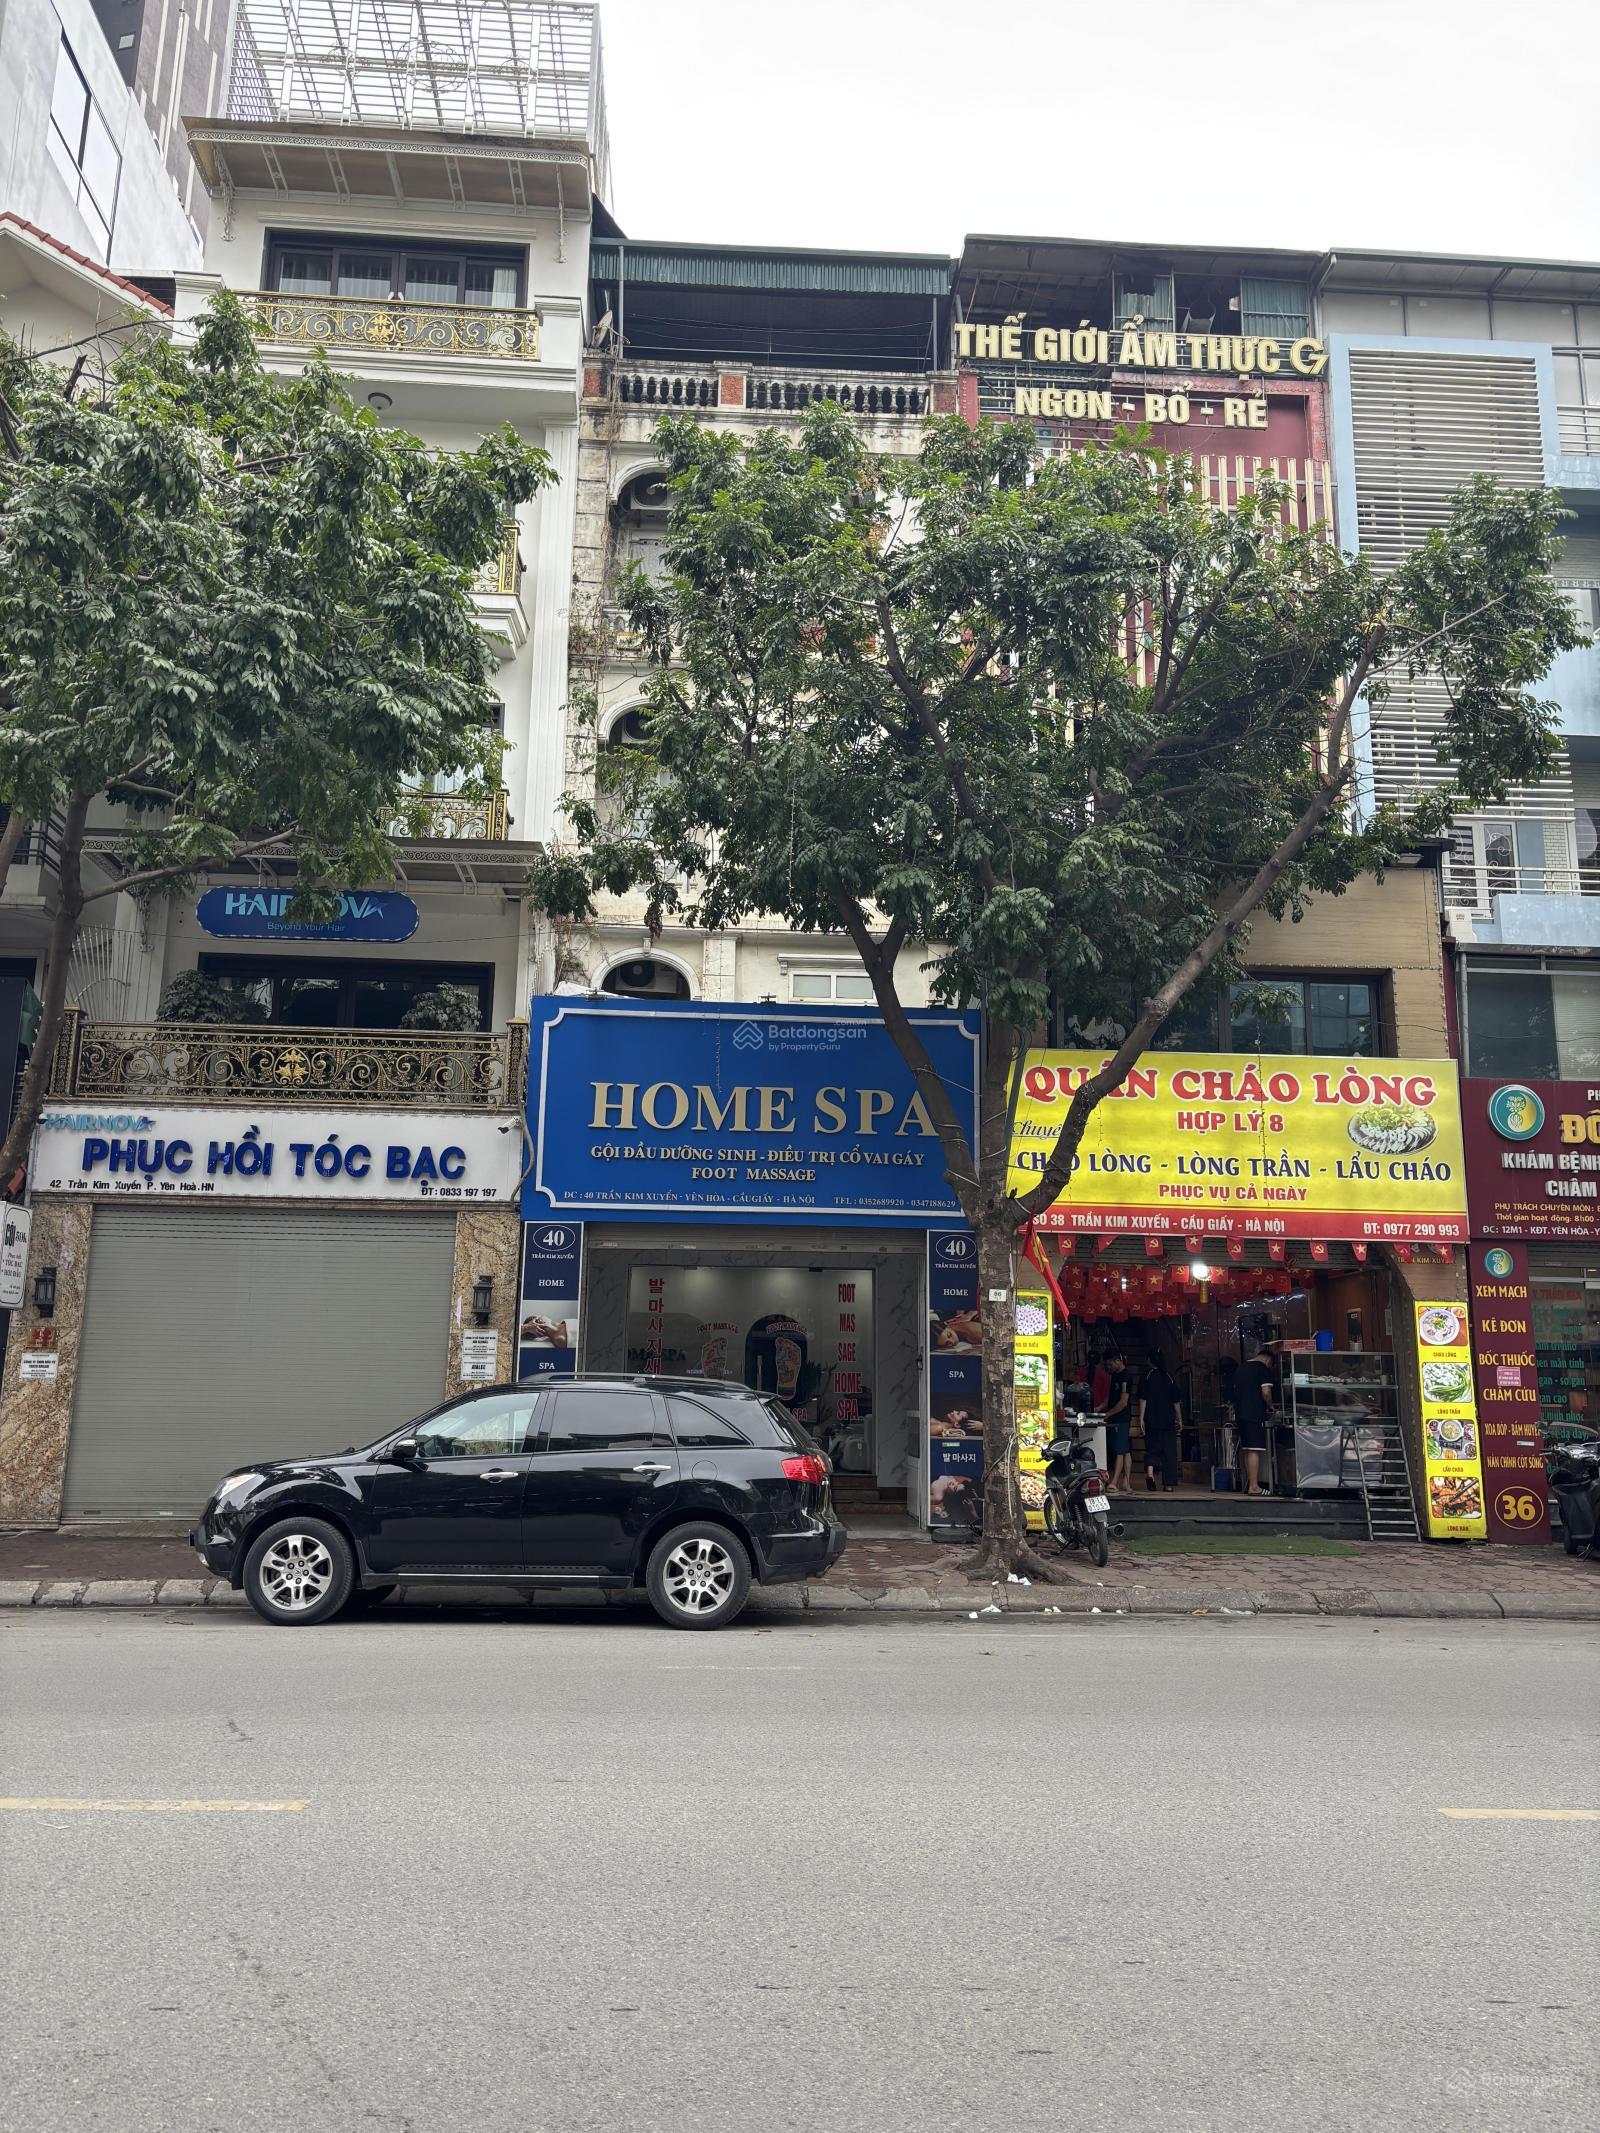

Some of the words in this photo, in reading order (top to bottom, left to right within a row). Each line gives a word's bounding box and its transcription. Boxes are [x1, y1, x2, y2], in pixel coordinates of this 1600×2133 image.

[955, 312, 1027, 360] THẾ
[1035, 319, 1108, 364] GIỚI
[1119, 314, 1177, 367] ẨM
[1186, 335, 1280, 381] THỰC
[1015, 387, 1112, 420] NGON
[1145, 380, 1194, 424] BỔ
[1224, 388, 1268, 430] RẺ
[305, 922, 323, 932] Your
[328, 923, 345, 932] Hair
[1172, 1064, 1300, 1103] CHÁO
[1312, 1066, 1436, 1106] LÒNG
[588, 1081, 796, 1133] HOME
[814, 1086, 939, 1136] SPA
[1177, 1110, 1226, 1134] HỢP
[1234, 1110, 1262, 1132] LÝ
[1269, 1114, 1284, 1132] 8
[82, 1138, 193, 1181] PHỤC
[207, 1124, 274, 1176] HỒI
[289, 1133, 372, 1178] TÓC
[386, 1145, 467, 1186] BẠC
[591, 1142, 620, 1161] GỘI
[623, 1140, 657, 1159] ĐẦU
[660, 1144, 714, 1161] DƯỠNG
[717, 1148, 756, 1162] SINH
[767, 1144, 805, 1163] ĐIỀU
[808, 1150, 836, 1165] TRỊ
[840, 1143, 861, 1164] CỔ
[864, 1152, 889, 1164] VAI
[892, 1150, 925, 1165] GÁY
[1502, 1149, 1554, 1169] KHÁM
[1089, 1148, 1151, 1173] LÒNG
[1178, 1151, 1240, 1175] LÒNG
[1247, 1148, 1311, 1177] TRẦN
[1336, 1151, 1380, 1179] LẨU
[1388, 1157, 1452, 1181] CHÁO
[691, 1167, 738, 1180] FOOT
[746, 1168, 816, 1181] MASSAGE
[50, 1179, 62, 1189] 42
[93, 1179, 110, 1190] Kim
[114, 1178, 141, 1192] Xuyến
[160, 1181, 175, 1191] Yên
[440, 1187, 462, 1197] 0833
[464, 1188, 478, 1197] 197
[481, 1188, 497, 1197] 197
[1159, 1184, 1203, 1200] PHỤC
[1209, 1186, 1230, 1202] VỤ
[1235, 1183, 1258, 1200] CẢ
[1263, 1185, 1308, 1201] NGÀY
[1546, 1177, 1598, 1197] CHÂM
[583, 1191, 594, 1199] 40
[624, 1192, 644, 1200] KIM
[646, 1189, 678, 1201] XUYẾN
[685, 1191, 704, 1202] YÊN
[706, 1191, 726, 1202] HÒA
[783, 1193, 796, 1203] HÀ
[799, 1193, 816, 1205] NỘI
[1513, 1201, 1538, 1211] TRÁCH
[1540, 1202, 1571, 1212] CHUYÊN
[1050, 1214, 1064, 1225] 38
[1105, 1215, 1128, 1228] KIM
[1131, 1213, 1170, 1229] XUYẾN
[1208, 1214, 1234, 1231] GIẤY
[1245, 1217, 1262, 1232] HÀ
[1264, 1217, 1285, 1233] NỘI
[1514, 1213, 1529, 1223] gian
[1363, 1222, 1381, 1234] ĐT:
[1383, 1223, 1411, 1235] 0977
[1415, 1224, 1435, 1236] 290
[1438, 1224, 1460, 1236] 993
[542, 1230, 565, 1247] 40
[945, 1240, 966, 1256] 40
[838, 1283, 856, 1303] FOOT
[943, 1288, 969, 1296] HOME
[1476, 1285, 1497, 1298] XEM
[1499, 1285, 1527, 1300] MẠCH
[840, 1313, 856, 1333] MAS
[1482, 1317, 1497, 1333] KÊ
[1500, 1319, 1526, 1333] ĐƠN
[838, 1342, 856, 1362] SAGE
[1479, 1350, 1499, 1365] BỐC
[1501, 1350, 1536, 1366] THUỐC
[834, 1372, 862, 1393] HOME
[949, 1370, 965, 1378] SPA
[793, 1408, 808, 1421] SPA
[837, 1400, 858, 1420] SPA
[1484, 1423, 1497, 1435] XOA
[952, 1452, 977, 1463] 마사지
[1502, 1495, 1536, 1521] 36
